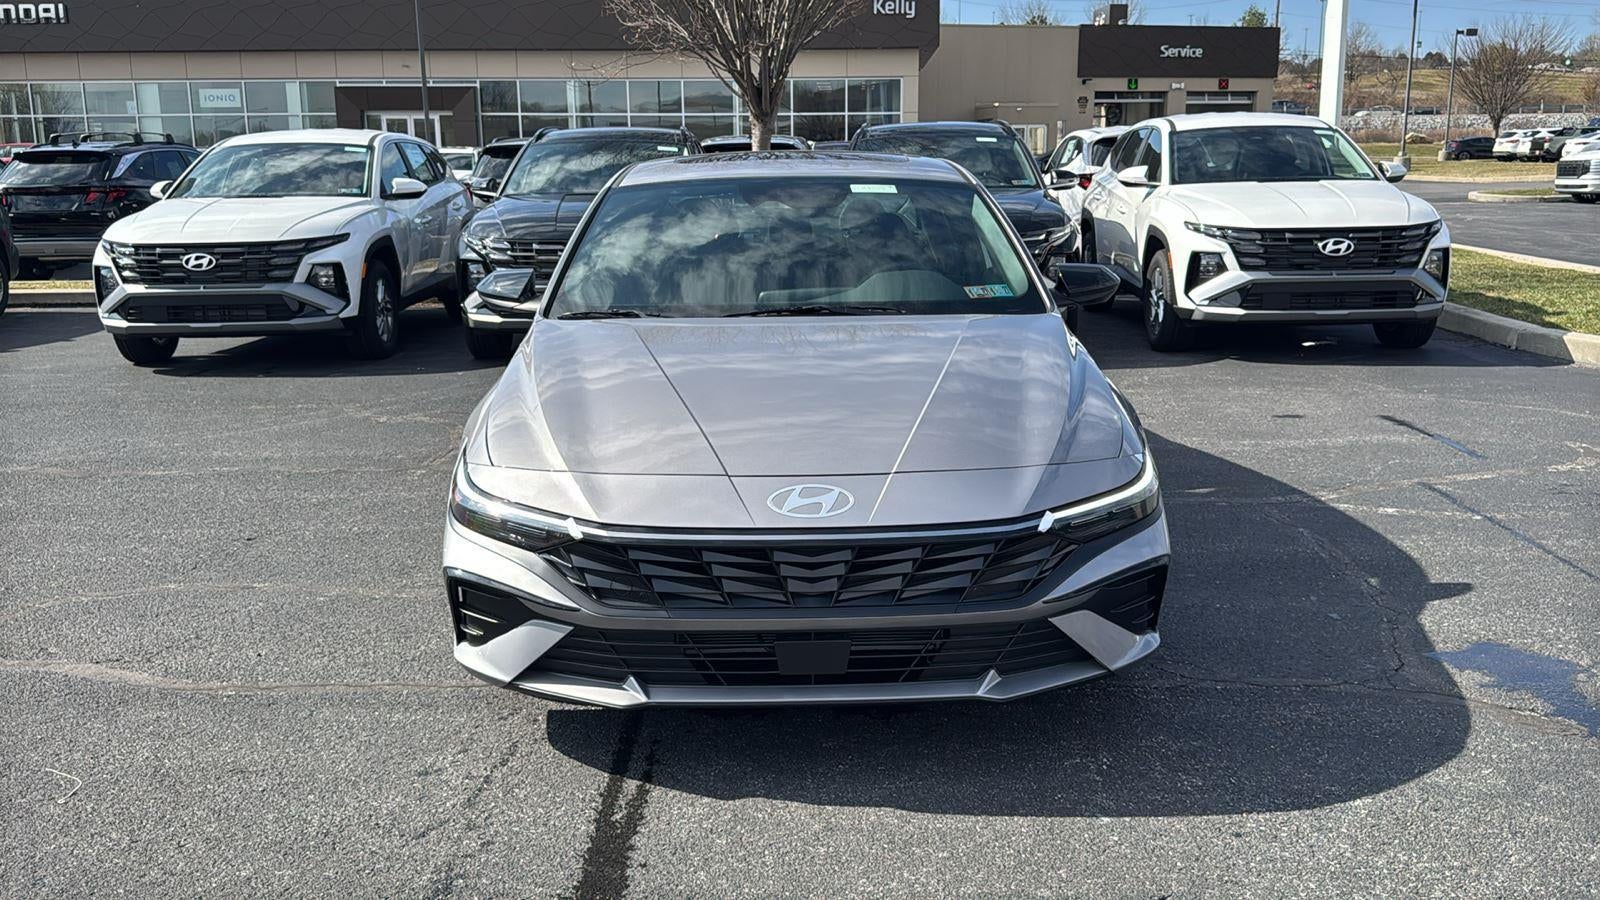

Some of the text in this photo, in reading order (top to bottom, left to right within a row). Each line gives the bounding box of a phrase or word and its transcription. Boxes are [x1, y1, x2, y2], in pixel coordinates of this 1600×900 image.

[0, 3, 65, 20] NDAI
[873, 0, 916, 18] Kelly
[1159, 44, 1204, 58] Service
